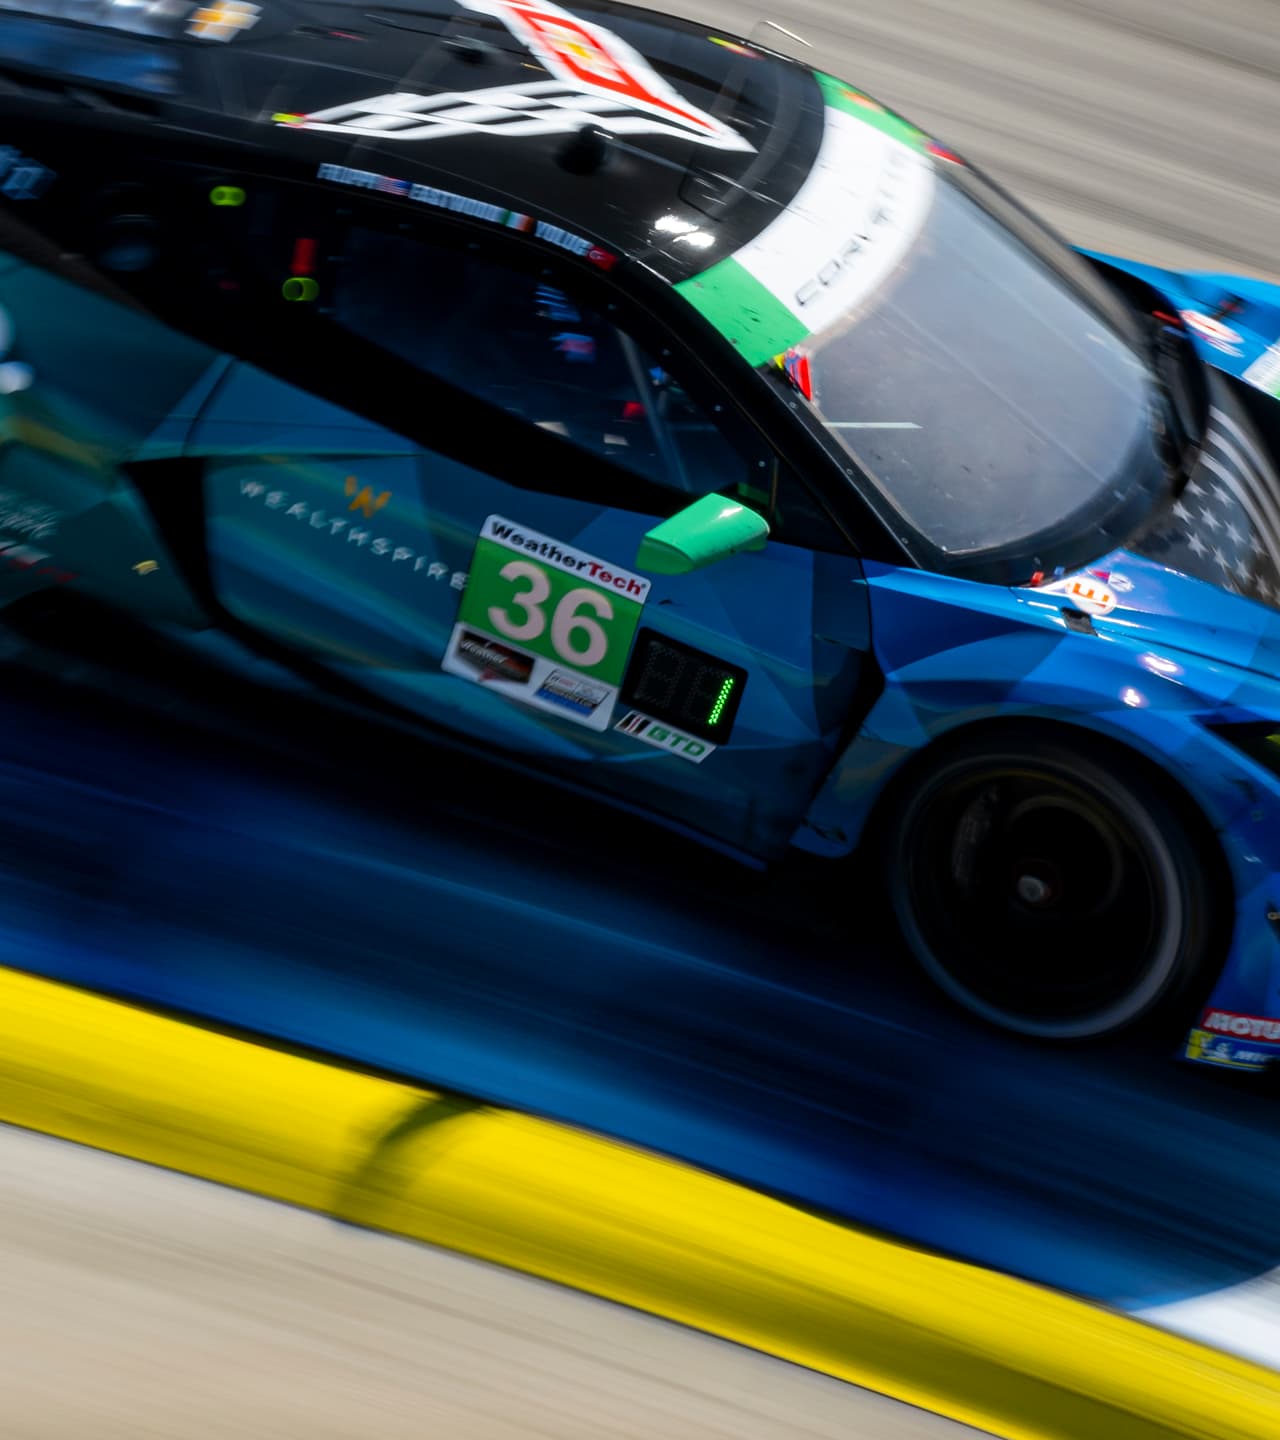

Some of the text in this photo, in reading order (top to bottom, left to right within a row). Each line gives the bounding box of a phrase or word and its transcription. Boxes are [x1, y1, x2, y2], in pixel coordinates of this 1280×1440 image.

[239, 479, 471, 591] WEALTHSPIRE
[490, 522, 646, 596] WeatherTech
[487, 560, 615, 667] 36
[647, 724, 706, 757] GTD
